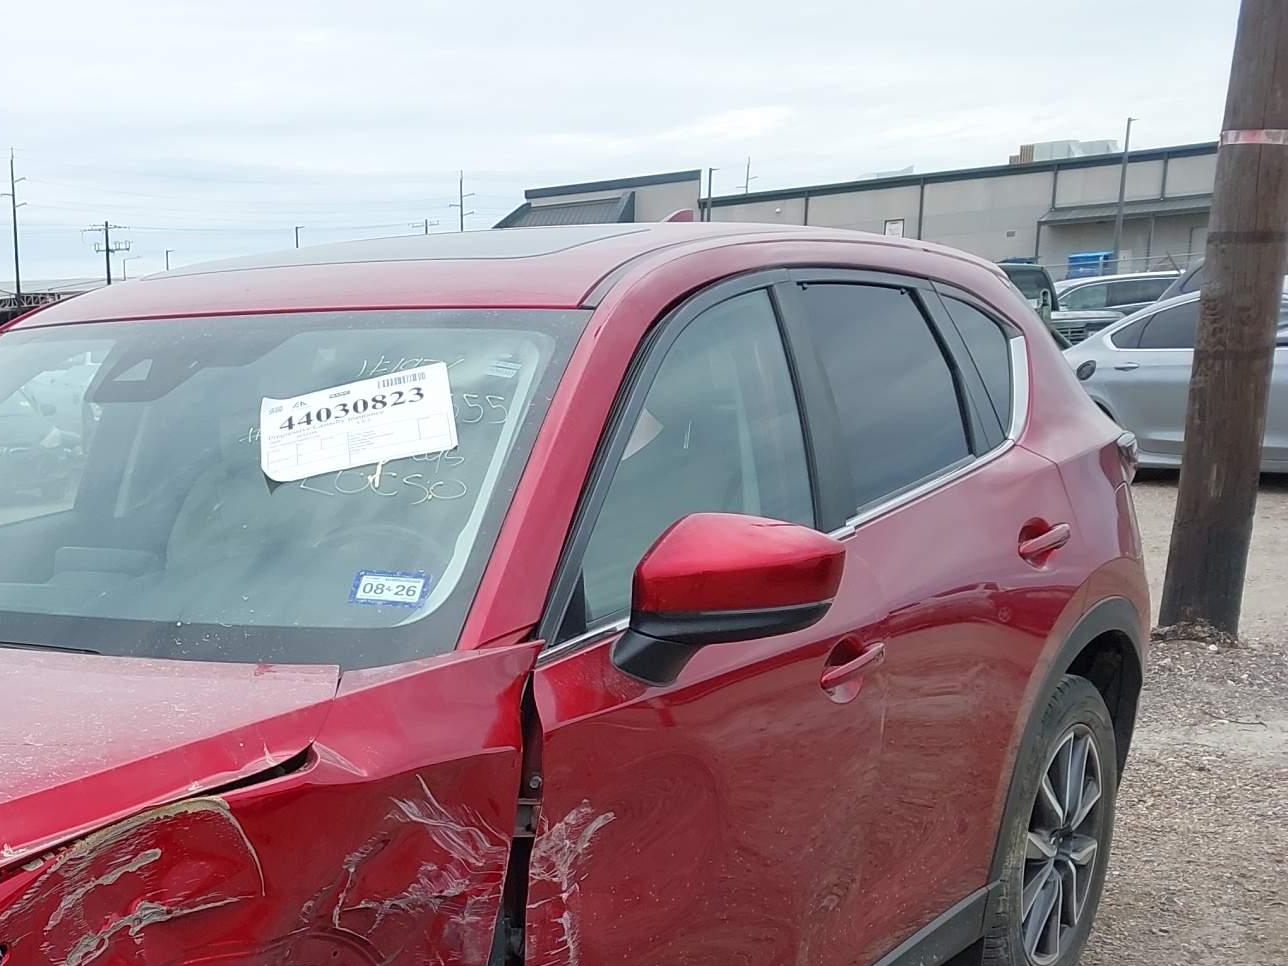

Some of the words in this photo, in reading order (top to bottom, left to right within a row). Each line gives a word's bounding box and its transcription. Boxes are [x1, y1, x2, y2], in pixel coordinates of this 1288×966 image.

[279, 386, 426, 431] 44030823
[362, 582, 386, 595] 08
[393, 584, 418, 597] 26
